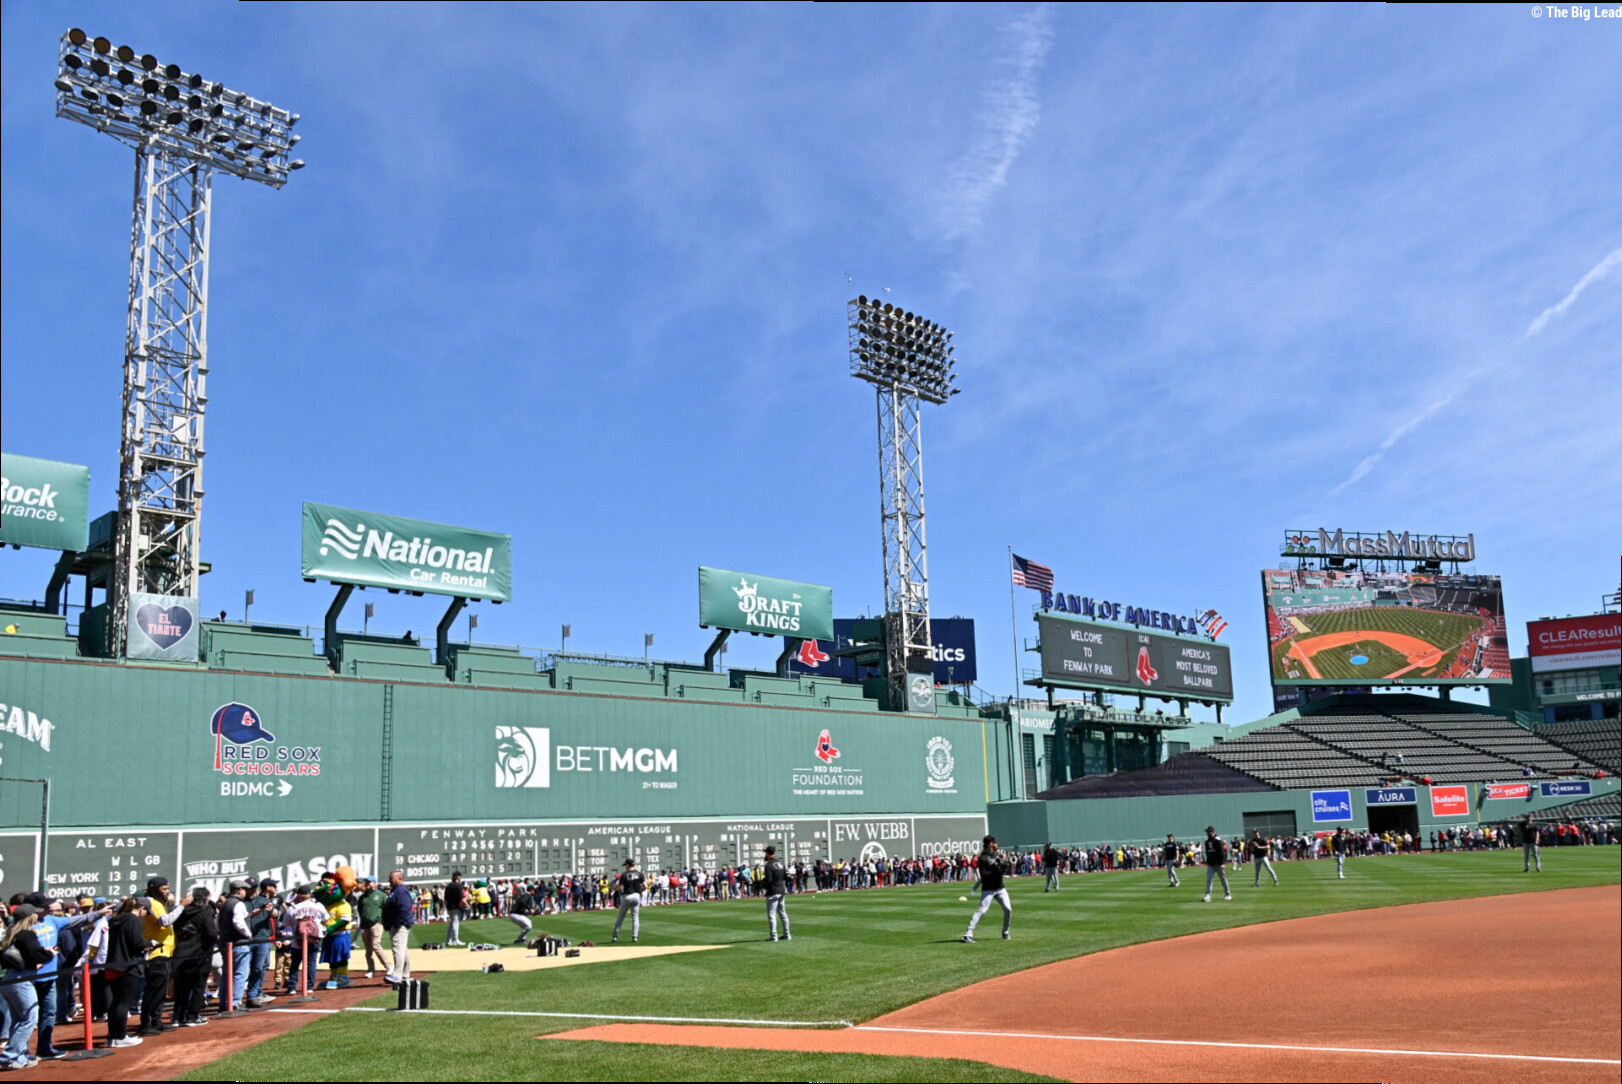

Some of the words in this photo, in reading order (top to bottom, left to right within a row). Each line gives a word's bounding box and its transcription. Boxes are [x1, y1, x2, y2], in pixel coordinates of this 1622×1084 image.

[1317, 527, 1475, 560] MassMutual
[363, 529, 493, 573] National
[410, 568, 437, 582] Car
[440, 571, 487, 588] Rental
[738, 594, 802, 616] DRAFT
[158, 613, 171, 624] EL
[1041, 590, 1095, 618] BANK
[1099, 599, 1122, 621] OF
[1124, 605, 1198, 634] AMERICA
[746, 610, 800, 631] KINGS
[147, 623, 181, 637] TIANTE
[1070, 629, 1103, 644] WELCOME
[1539, 624, 1621, 643] CLEAResult
[1083, 647, 1093, 658] TO
[1181, 647, 1211, 661] AMERICA'S
[1064, 659, 1093, 673] FENWAY
[1094, 662, 1113, 676] PARK
[1176, 660, 1192, 673] MOST
[1193, 662, 1218, 676] BELOVED
[1183, 675, 1213, 688] BALLPARK
[1576, 692, 1605, 701] WELCOME
[224, 746, 269, 760] RED
[277, 747, 321, 761] SOX
[556, 746, 678, 773] BETMGM
[222, 762, 321, 775] SCHOLARS
[792, 774, 863, 786] FOUNDATION
[221, 781, 274, 797] BIDMC
[1504, 786, 1529, 797] TICKET
[1314, 799, 1327, 807] city
[1434, 795, 1465, 803] Safelite
[1315, 805, 1339, 813] cruises
[420, 829, 486, 839] FENWAY
[498, 828, 537, 838] PARK
[588, 826, 634, 835] AMERICAN
[638, 825, 671, 834] LEAGUE
[727, 824, 764, 832] NATIONAL
[766, 823, 795, 831] LEAGUE
[865, 822, 909, 841] WEBB
[75, 838, 97, 849] AL
[105, 837, 147, 848] EAST
[396, 843, 403, 852] P
[451, 841, 458, 850] 2
[460, 841, 467, 849] 3
[471, 841, 478, 849] 4
[480, 841, 486, 849] 5
[488, 840, 495, 849] 6
[499, 840, 504, 848] 7
[507, 840, 513, 848] 8
[515, 839, 521, 848] 9
[525, 839, 534, 848] 10
[541, 838, 548, 847] R
[564, 837, 570, 846] E
[635, 836, 640, 844] P
[921, 838, 981, 855] moderna
[591, 848, 605, 856] SEA
[646, 846, 660, 855] LAD
[111, 857, 120, 867] W
[130, 856, 138, 866] L
[144, 855, 161, 865] GB
[407, 854, 439, 864] CHICAGO
[591, 857, 605, 866] TOR
[647, 855, 659, 863] TEX
[186, 862, 219, 877] WHO
[220, 860, 247, 874] BUT
[407, 866, 439, 877] BOSTON
[70, 872, 99, 883] YORK
[109, 871, 122, 882] 13
[129, 870, 137, 881] 8
[48, 887, 96, 898] ORONTO
[108, 885, 120, 896] 12
[129, 884, 138, 895] 9
